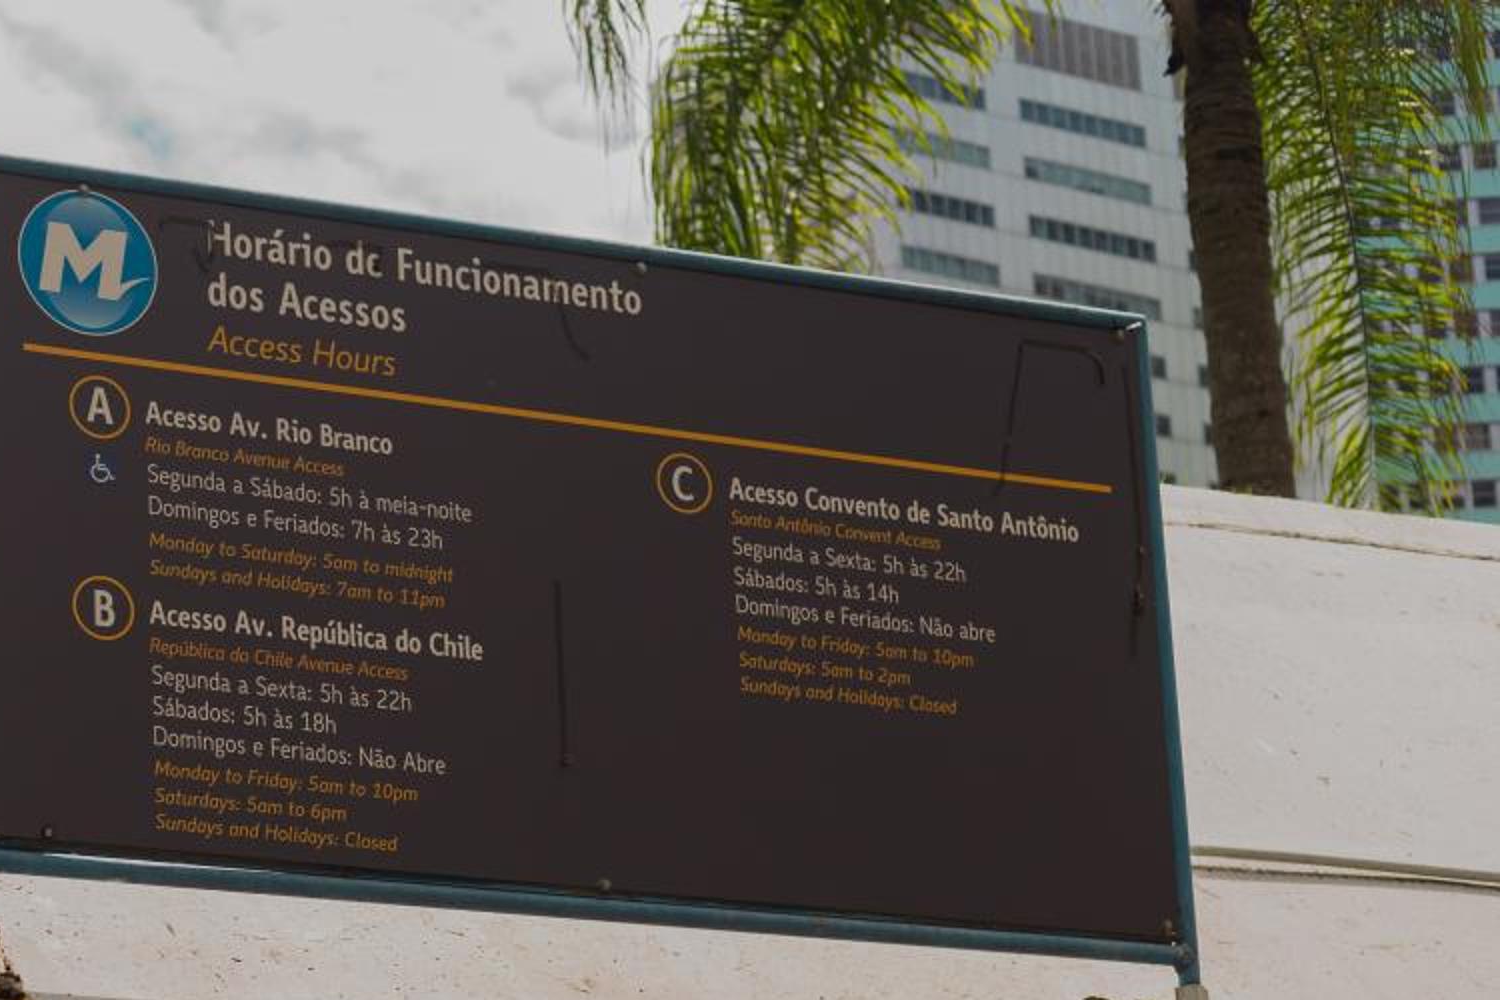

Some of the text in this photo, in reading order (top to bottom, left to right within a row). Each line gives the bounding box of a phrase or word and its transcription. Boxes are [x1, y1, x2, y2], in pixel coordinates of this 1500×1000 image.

[208, 220, 332, 273] Horário
[397, 247, 642, 316] Funcionamento
[208, 271, 407, 333] dos Acessos
[207, 325, 396, 377] Access Hours
[88, 387, 113, 425] A
[146, 401, 392, 454] Acesso Av. Rio Branco
[145, 437, 344, 476] Rio Branco Avenue Access
[148, 464, 472, 522] Segunda a Sábado: 5h à meia-noite
[671, 466, 694, 502] C
[148, 495, 442, 549] Domingos e Feriados: 7h às 23h
[730, 477, 1079, 542] Acesso Convento de Santo Antônio
[731, 511, 940, 550] Santo Antônio Convent Access
[149, 532, 452, 585] Monday to Saturday: 5am to midnight
[733, 536, 966, 582] Segunda a Sexta: 5h às 22h
[150, 560, 445, 609] Sundays and Holidays: 7am to 11pm
[734, 566, 899, 603] Sábados: 5h às 14h
[94, 591, 115, 627] B
[150, 601, 483, 660] Acesso Av. República do Chile
[736, 594, 996, 643] Domingos e Feriados: Não abre
[150, 637, 408, 681] República do Chile Avenue Access
[738, 626, 973, 669] Monday to Friday: 5am to 10pm
[740, 652, 910, 687] Saturdays: 5am to 2pm
[152, 665, 411, 711] Segunda a Sexta: 5h às 22h
[740, 676, 956, 714] Sundays and Holidays: Closed
[153, 696, 336, 734] Sábados: 5h às 18h
[153, 725, 446, 774] Domingos e Feriados: Não Abre
[155, 760, 418, 803] Monday to Friday: 5am to 10pm
[155, 788, 346, 823] Saturdays: 5am to 6pm
[156, 813, 398, 851] Sundays and Holidays: Closed
